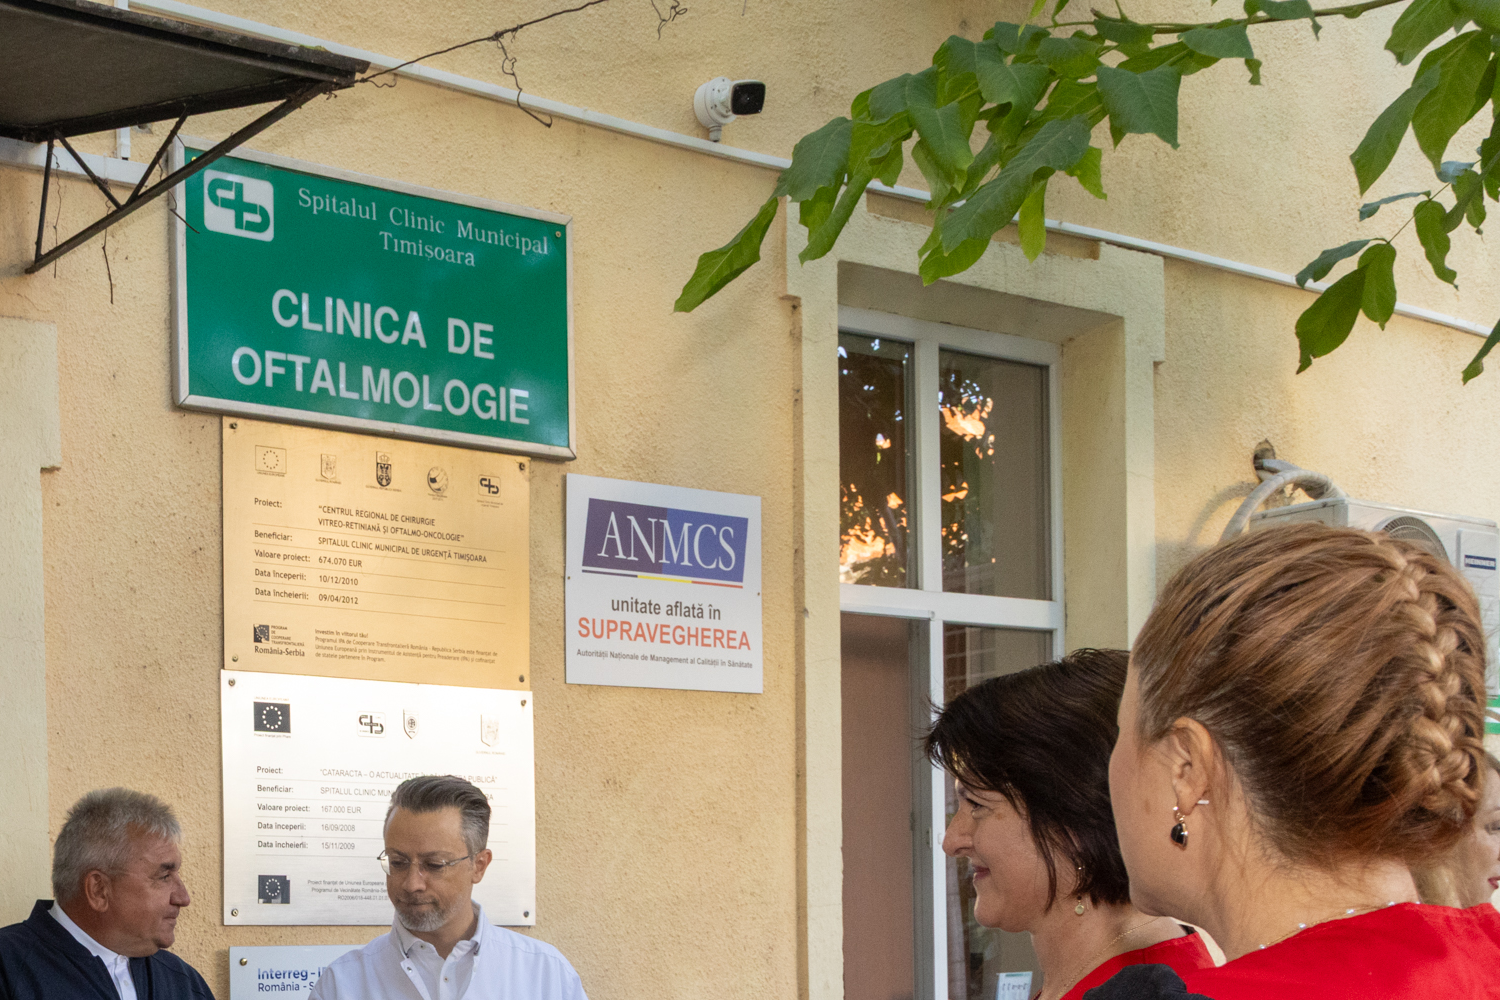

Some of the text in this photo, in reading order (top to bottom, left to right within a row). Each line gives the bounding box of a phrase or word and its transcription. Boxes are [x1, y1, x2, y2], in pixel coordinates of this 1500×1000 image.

[298, 187, 548, 256] Spitalul Clinic Municipal
[271, 288, 495, 361] CLINICA DE
[231, 346, 531, 425] OFTALMOLOGIE
[254, 497, 282, 509] Proiect:
[318, 518, 381, 532] VITREO-RETINIANĂ
[382, 525, 389, 535] ȘI
[355, 509, 389, 521] REGIONAL
[390, 513, 399, 522] DE
[400, 515, 436, 527] CHIRURGIE
[254, 530, 488, 563] Beneficiar: SPITALUL CLINIC MUNICIPAL DE URGENȚĂ TIMIȘOARA
[597, 511, 736, 571] ANMCS
[254, 549, 363, 568] Valoare proiect: 674.070 EUR
[254, 568, 359, 586] Data începerii: 10/12/2010
[255, 587, 359, 605] Data încheierii: 09/04/2012
[611, 597, 721, 620] unitate aflată în
[577, 616, 752, 651] SUPRAVEGHEREA
[254, 645, 305, 657] România-Serbia
[576, 649, 609, 661] Autorității
[609, 651, 640, 662] Naționale
[640, 653, 649, 661] de
[649, 654, 689, 665] Management
[690, 656, 696, 665] al
[256, 765, 283, 775] Proiect:
[369, 771, 376, 779] O
[257, 784, 294, 794] Beneficiar:
[320, 786, 353, 796] SPITALUL
[353, 788, 377, 797] CLINIC
[257, 803, 362, 814] Valoare proiect: 167.000 EUR
[257, 822, 273, 830] Data
[321, 823, 356, 832] 16/09/2008
[257, 840, 273, 848] Data
[321, 842, 356, 850] 15/11/2009
[257, 967, 308, 981] Interreg
[257, 981, 300, 992] România
